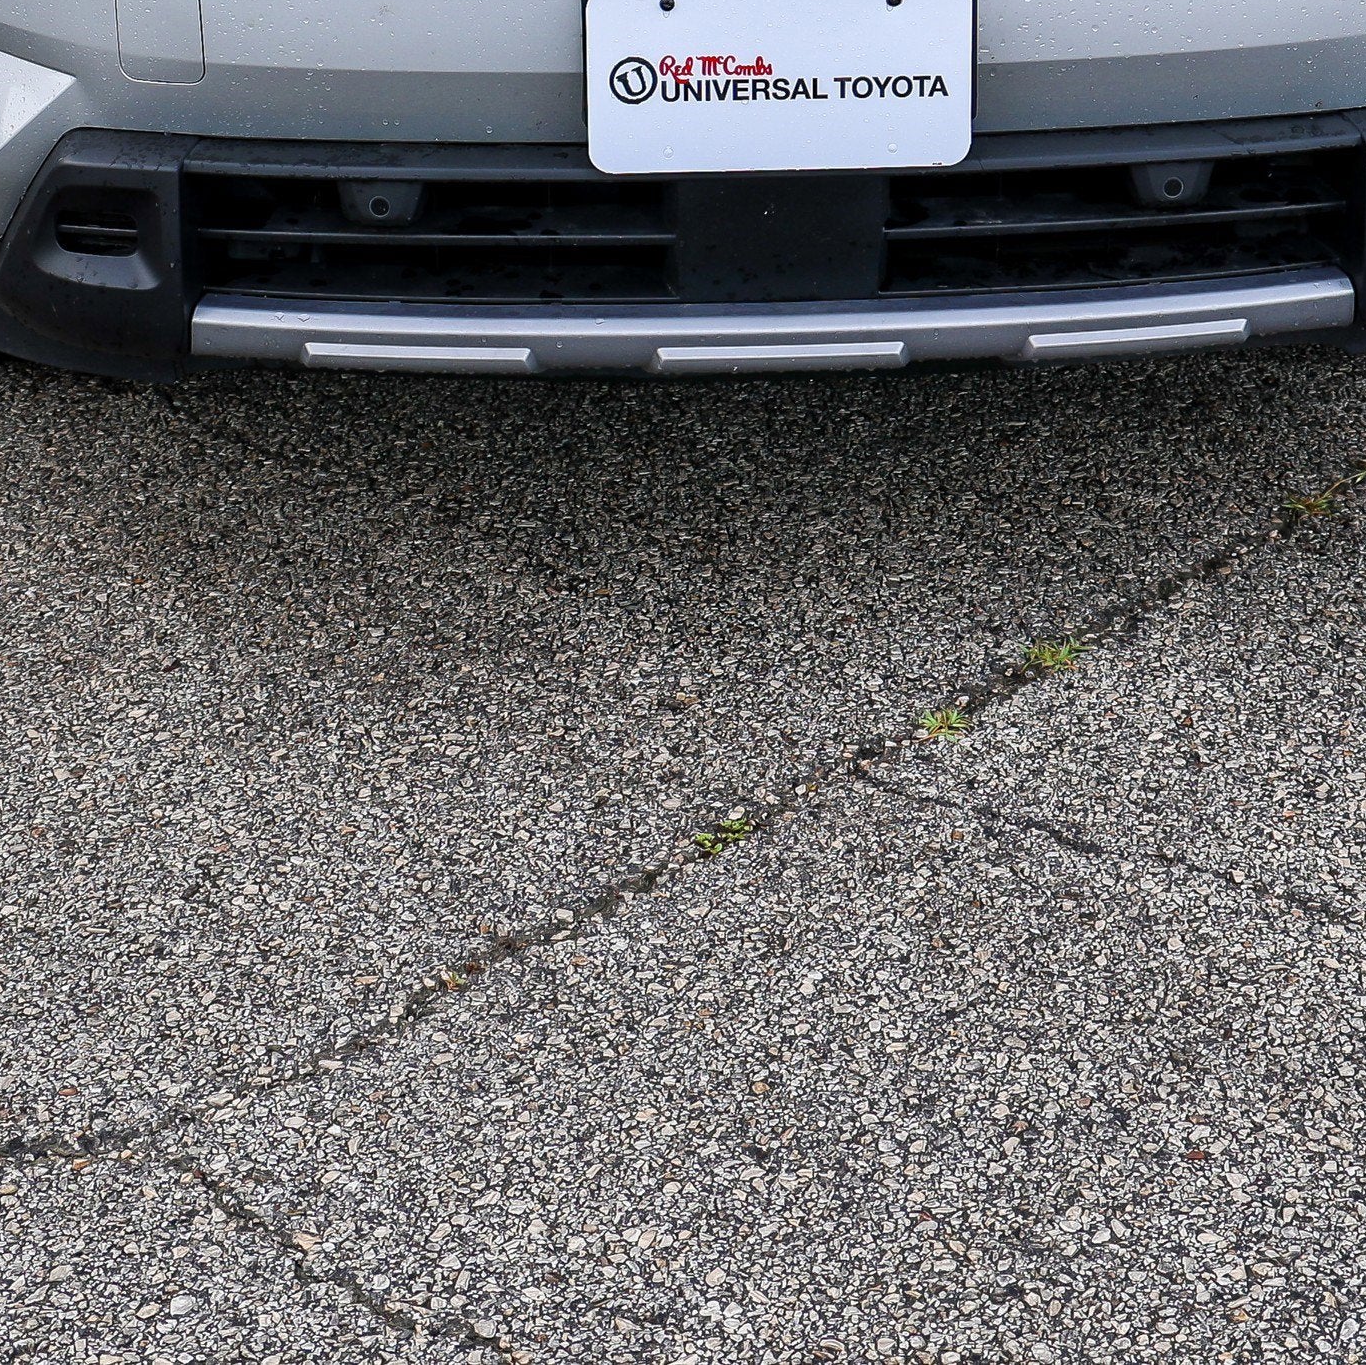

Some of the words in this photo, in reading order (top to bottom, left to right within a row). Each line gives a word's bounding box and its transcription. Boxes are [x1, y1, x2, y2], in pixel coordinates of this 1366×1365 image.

[659, 55, 694, 84] Red
[696, 55, 773, 76] McCombs
[661, 77, 828, 102] UNIVERSAL
[834, 75, 949, 99] TOYOTA
